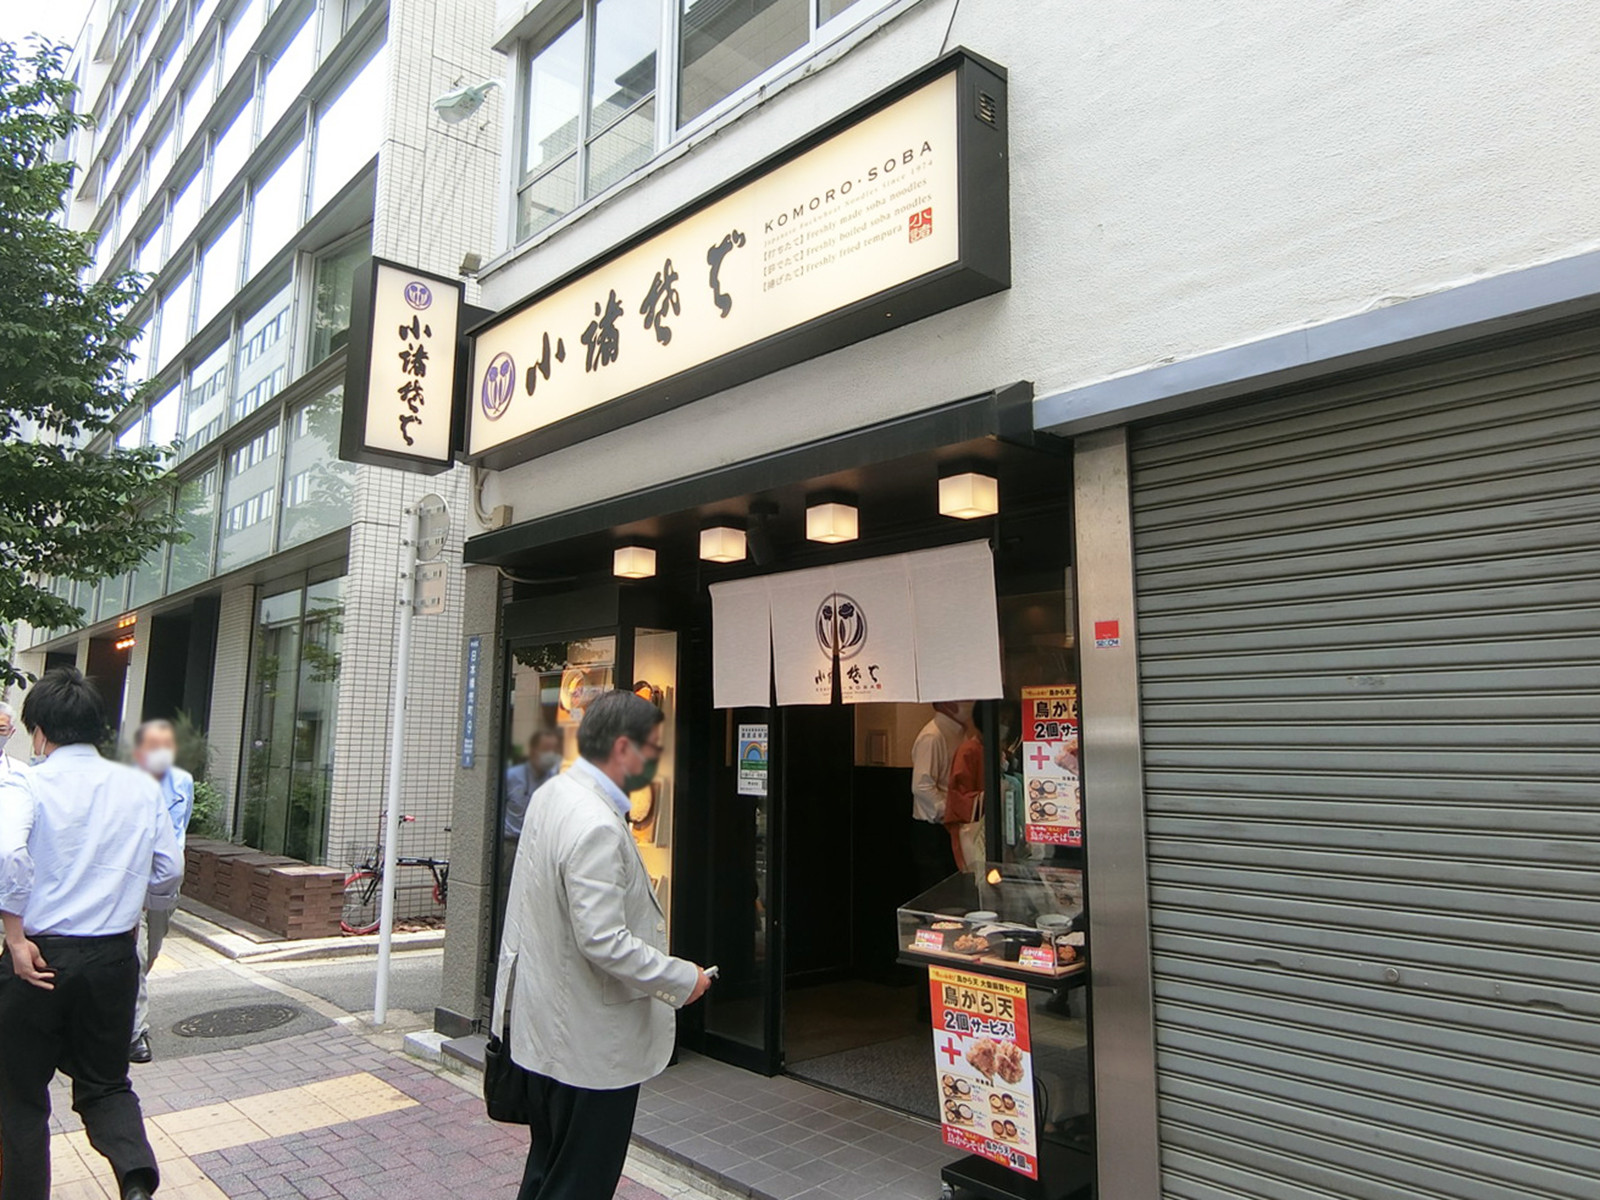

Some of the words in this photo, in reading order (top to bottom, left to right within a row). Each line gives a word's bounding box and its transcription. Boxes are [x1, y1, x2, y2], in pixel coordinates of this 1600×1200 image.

[889, 178, 928, 201] noodles
[894, 193, 932, 216] noodles
[863, 224, 902, 247] tempura
[944, 985, 1014, 1019] 鳥から天
